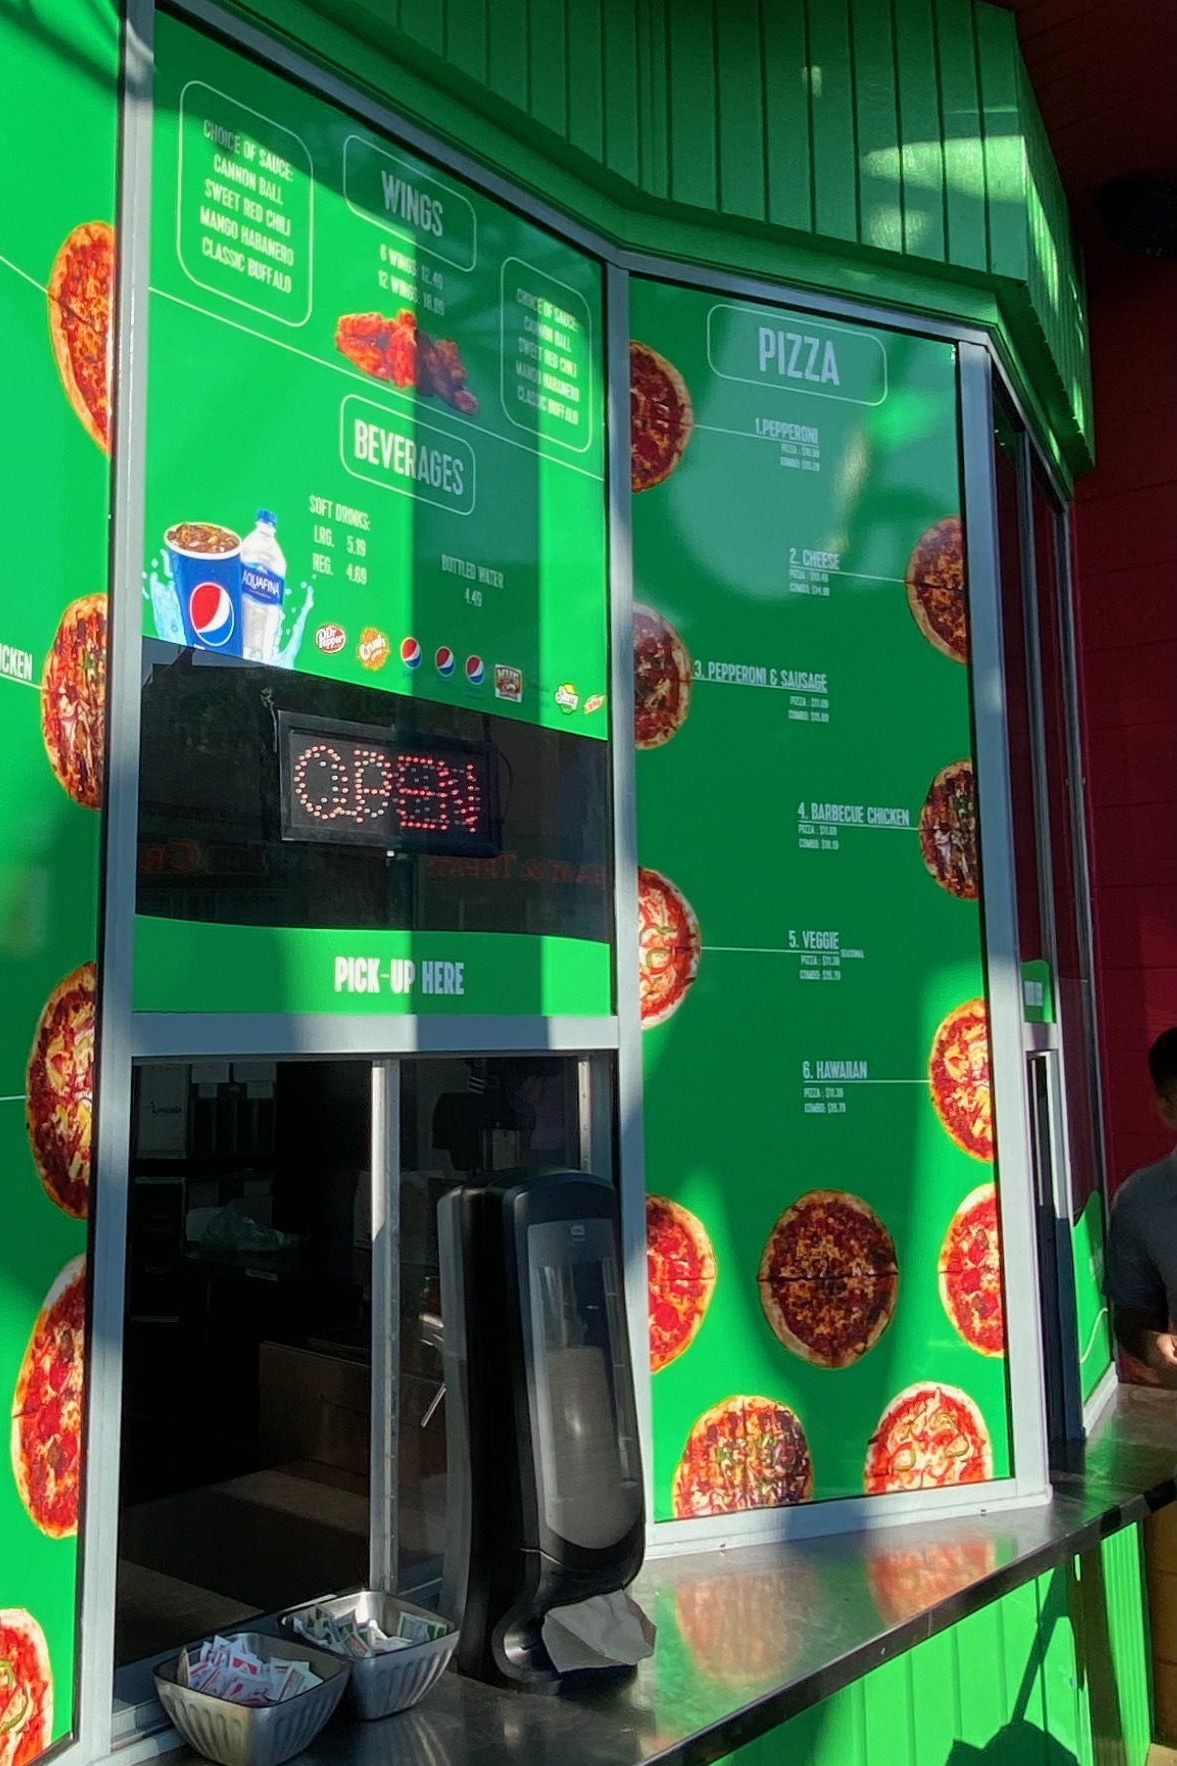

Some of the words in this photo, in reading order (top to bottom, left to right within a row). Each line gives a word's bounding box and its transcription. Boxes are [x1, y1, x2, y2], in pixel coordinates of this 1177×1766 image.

[203, 119, 240, 154] CHOICE
[243, 140, 256, 162] OF
[259, 147, 293, 182] SAUCE:
[214, 153, 256, 190] CANNON
[258, 175, 283, 206] BALL
[205, 178, 240, 212] SWEET
[243, 191, 263, 224] RED
[266, 208, 291, 237] CHILI
[381, 170, 444, 237] WINGS
[200, 205, 238, 240] MANGO
[241, 225, 294, 267] HABANERO
[202, 236, 245, 272] CLASSIC
[378, 269, 389, 290] 12
[758, 327, 840, 386] PIZZA
[354, 418, 464, 496] BEVERAGES
[309, 495, 333, 519] SOFT
[335, 504, 371, 531] DRINKS:
[313, 524, 335, 548] LRG.
[347, 535, 366, 557] 5.19
[312, 552, 334, 576] REG.
[442, 554, 476, 580] BOTTLED
[477, 565, 504, 589] WATER
[803, 549, 840, 570] CHEESE
[242, 569, 280, 599] AQUAFINA
[465, 588, 483, 607] 4.49
[694, 660, 705, 678] 3.
[708, 661, 767, 685] PEPPERONI
[770, 668, 777, 686] &
[781, 670, 827, 692] SAUSAGE
[797, 802, 809, 820] 4.
[811, 802, 864, 823] BARBECUE
[867, 806, 909, 826] CHICKEN
[788, 930, 799, 948] 5.
[802, 931, 839, 949] VEGGIE
[334, 956, 416, 994] PICK-UP
[422, 960, 465, 995] HERE
[803, 1060, 814, 1079] 6.
[816, 1060, 867, 1079] HAWAIIAN
